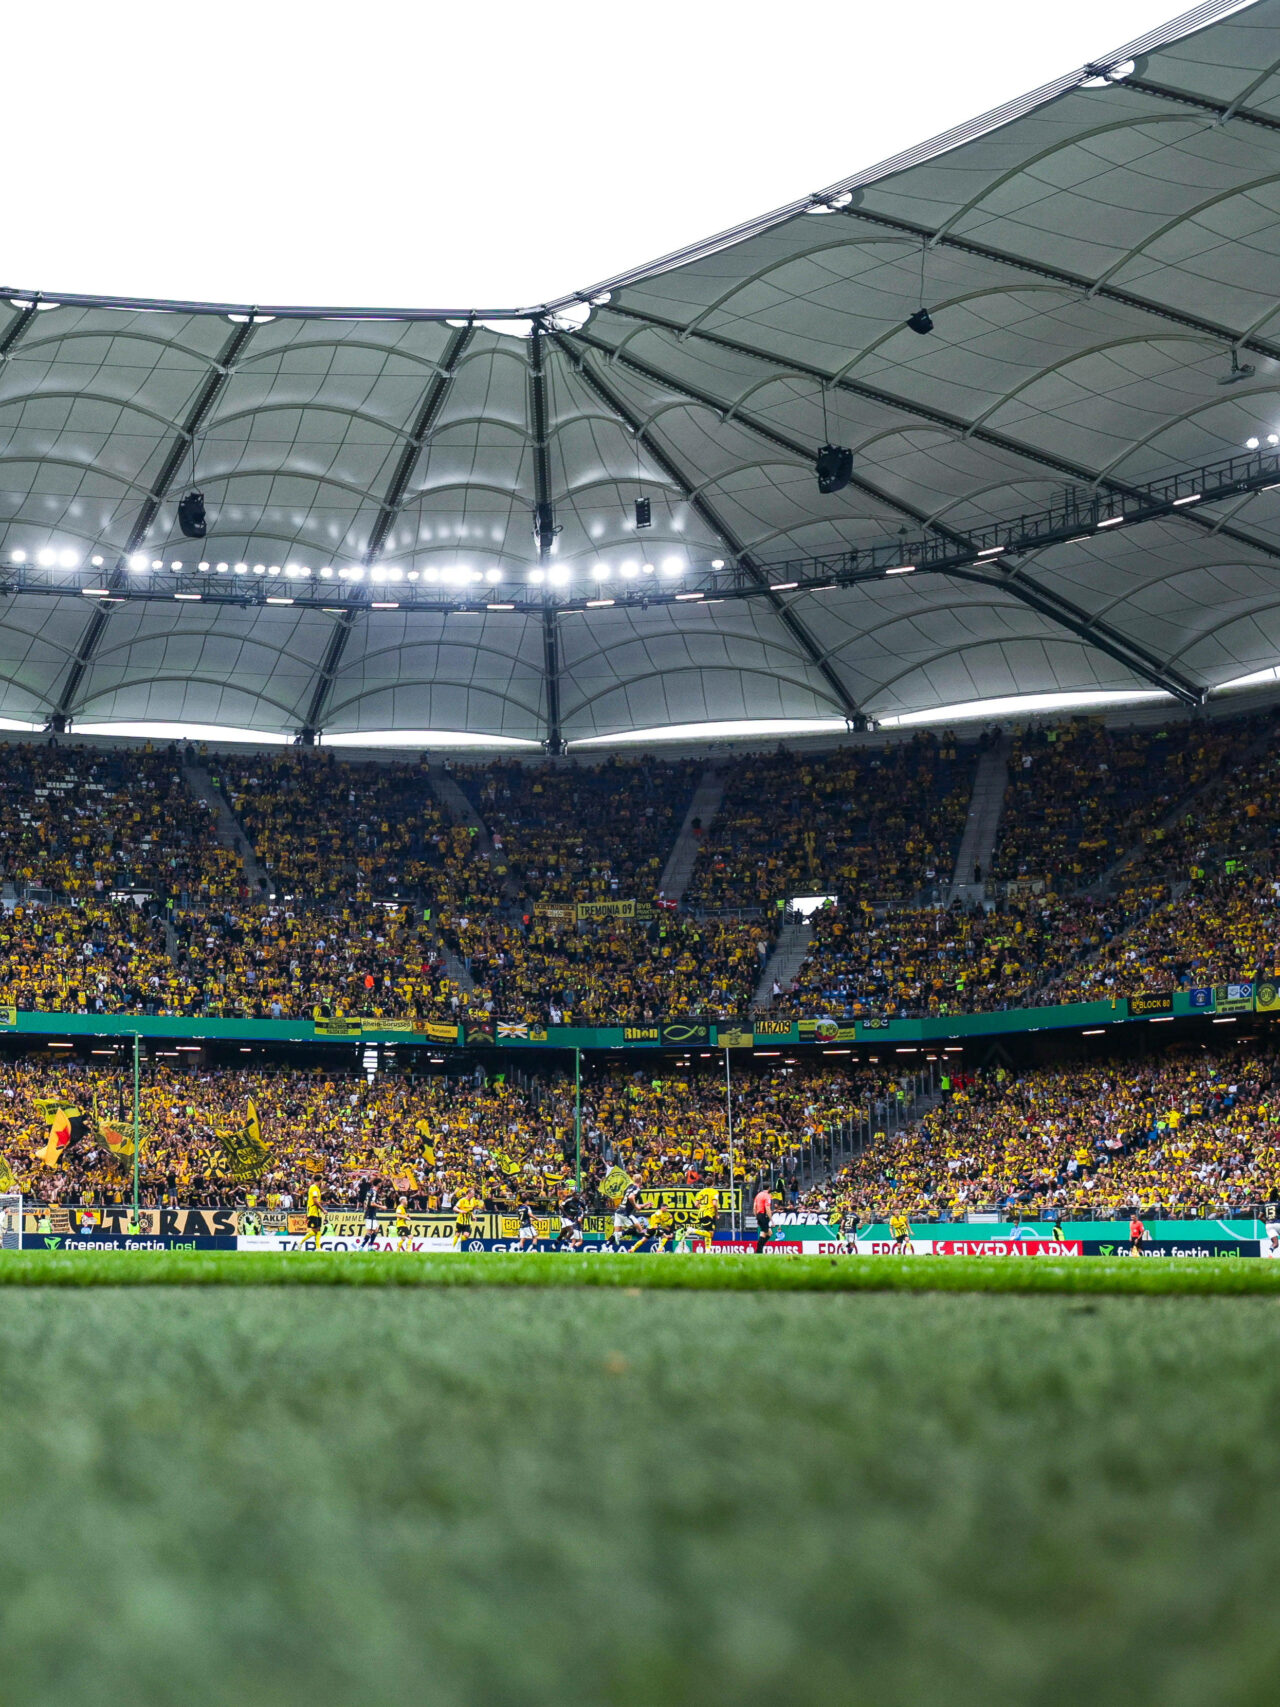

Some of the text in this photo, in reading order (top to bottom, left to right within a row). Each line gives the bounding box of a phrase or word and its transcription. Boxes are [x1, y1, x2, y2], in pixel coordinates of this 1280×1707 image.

[581, 903, 619, 916] TREMONIA
[624, 1027, 658, 1039] Rhön
[263, 1214, 286, 1223] AKLP
[342, 1214, 365, 1222] IMME
